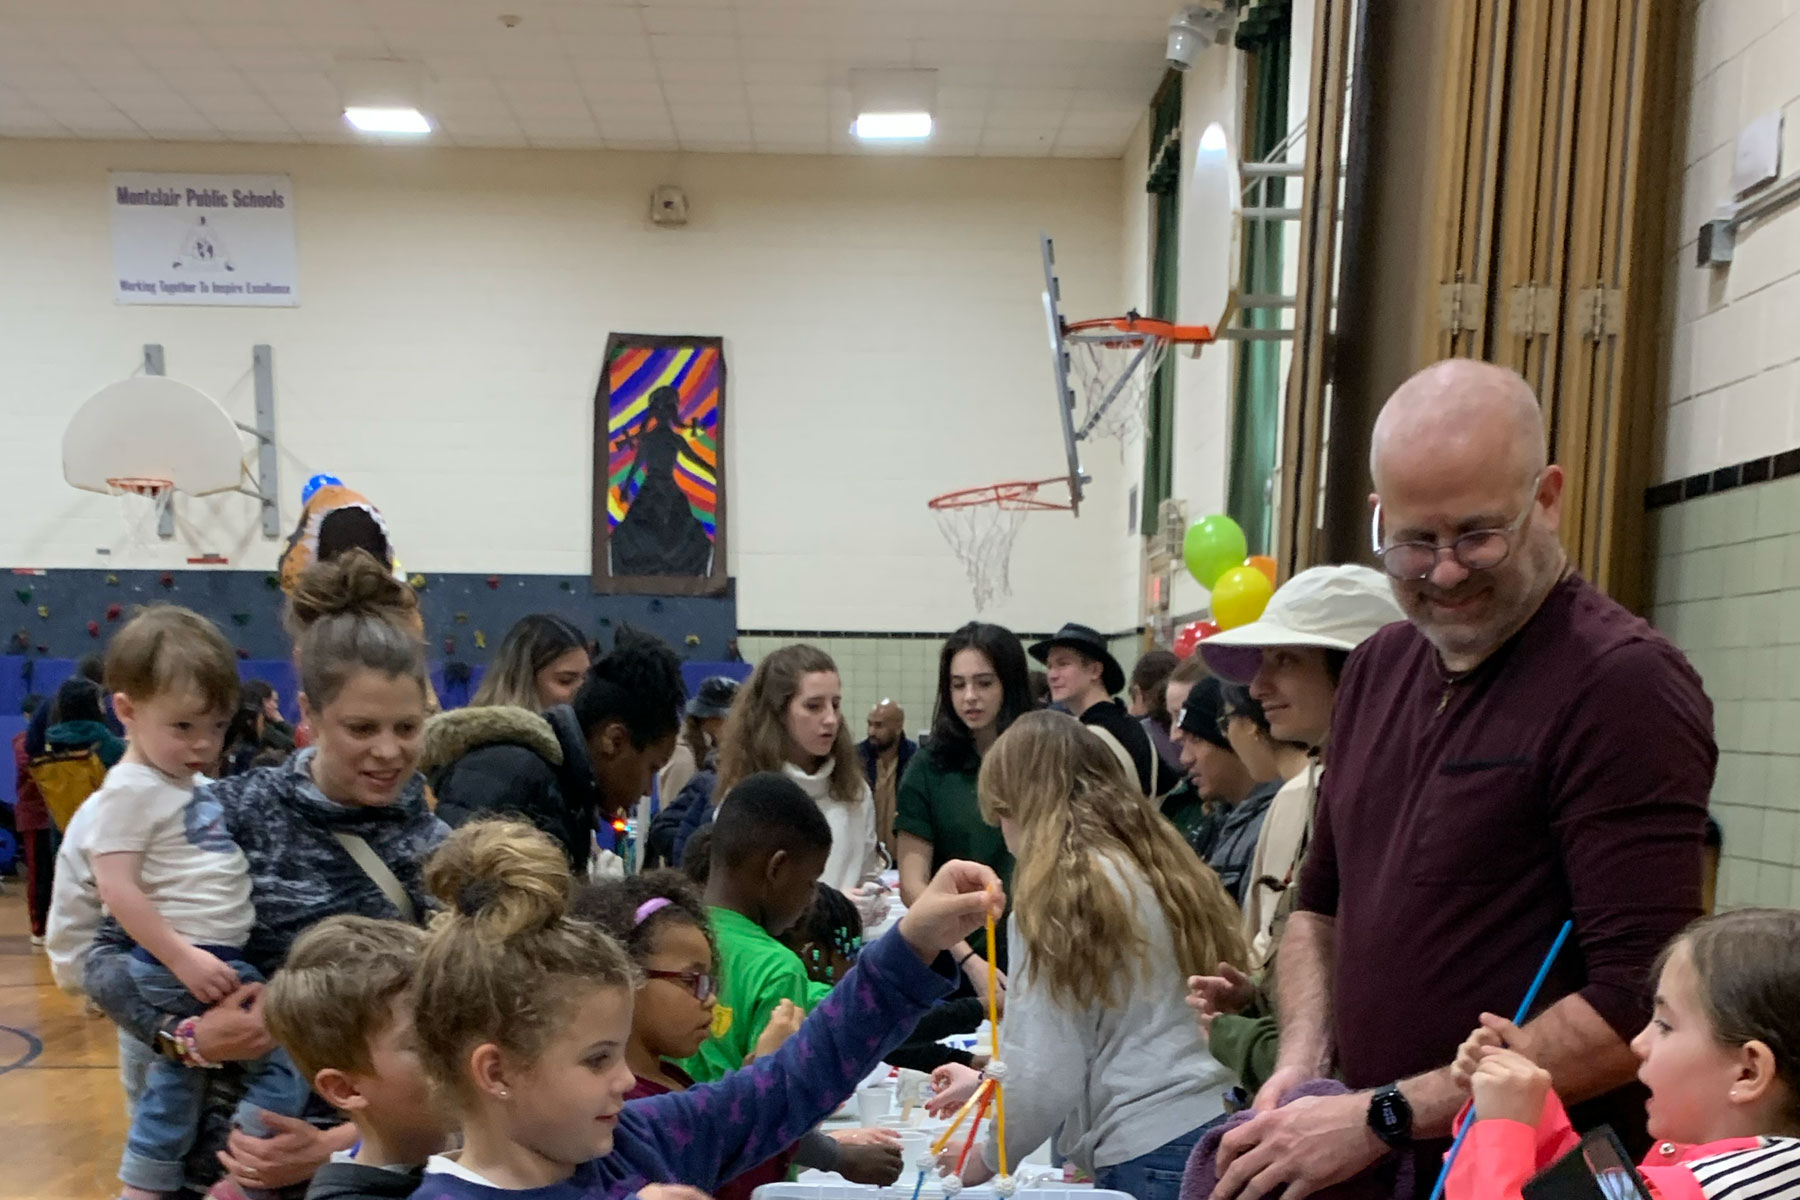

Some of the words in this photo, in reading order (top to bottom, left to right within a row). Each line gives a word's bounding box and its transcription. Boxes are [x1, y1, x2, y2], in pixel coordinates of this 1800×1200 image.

[117, 187, 181, 206] Montclair
[186, 188, 228, 207] Public
[232, 189, 285, 208] Schools
[120, 280, 156, 294] Working
[159, 281, 196, 295] Together
[200, 281, 209, 293] To
[212, 282, 243, 295] Inspire
[246, 282, 291, 294] Excellence
